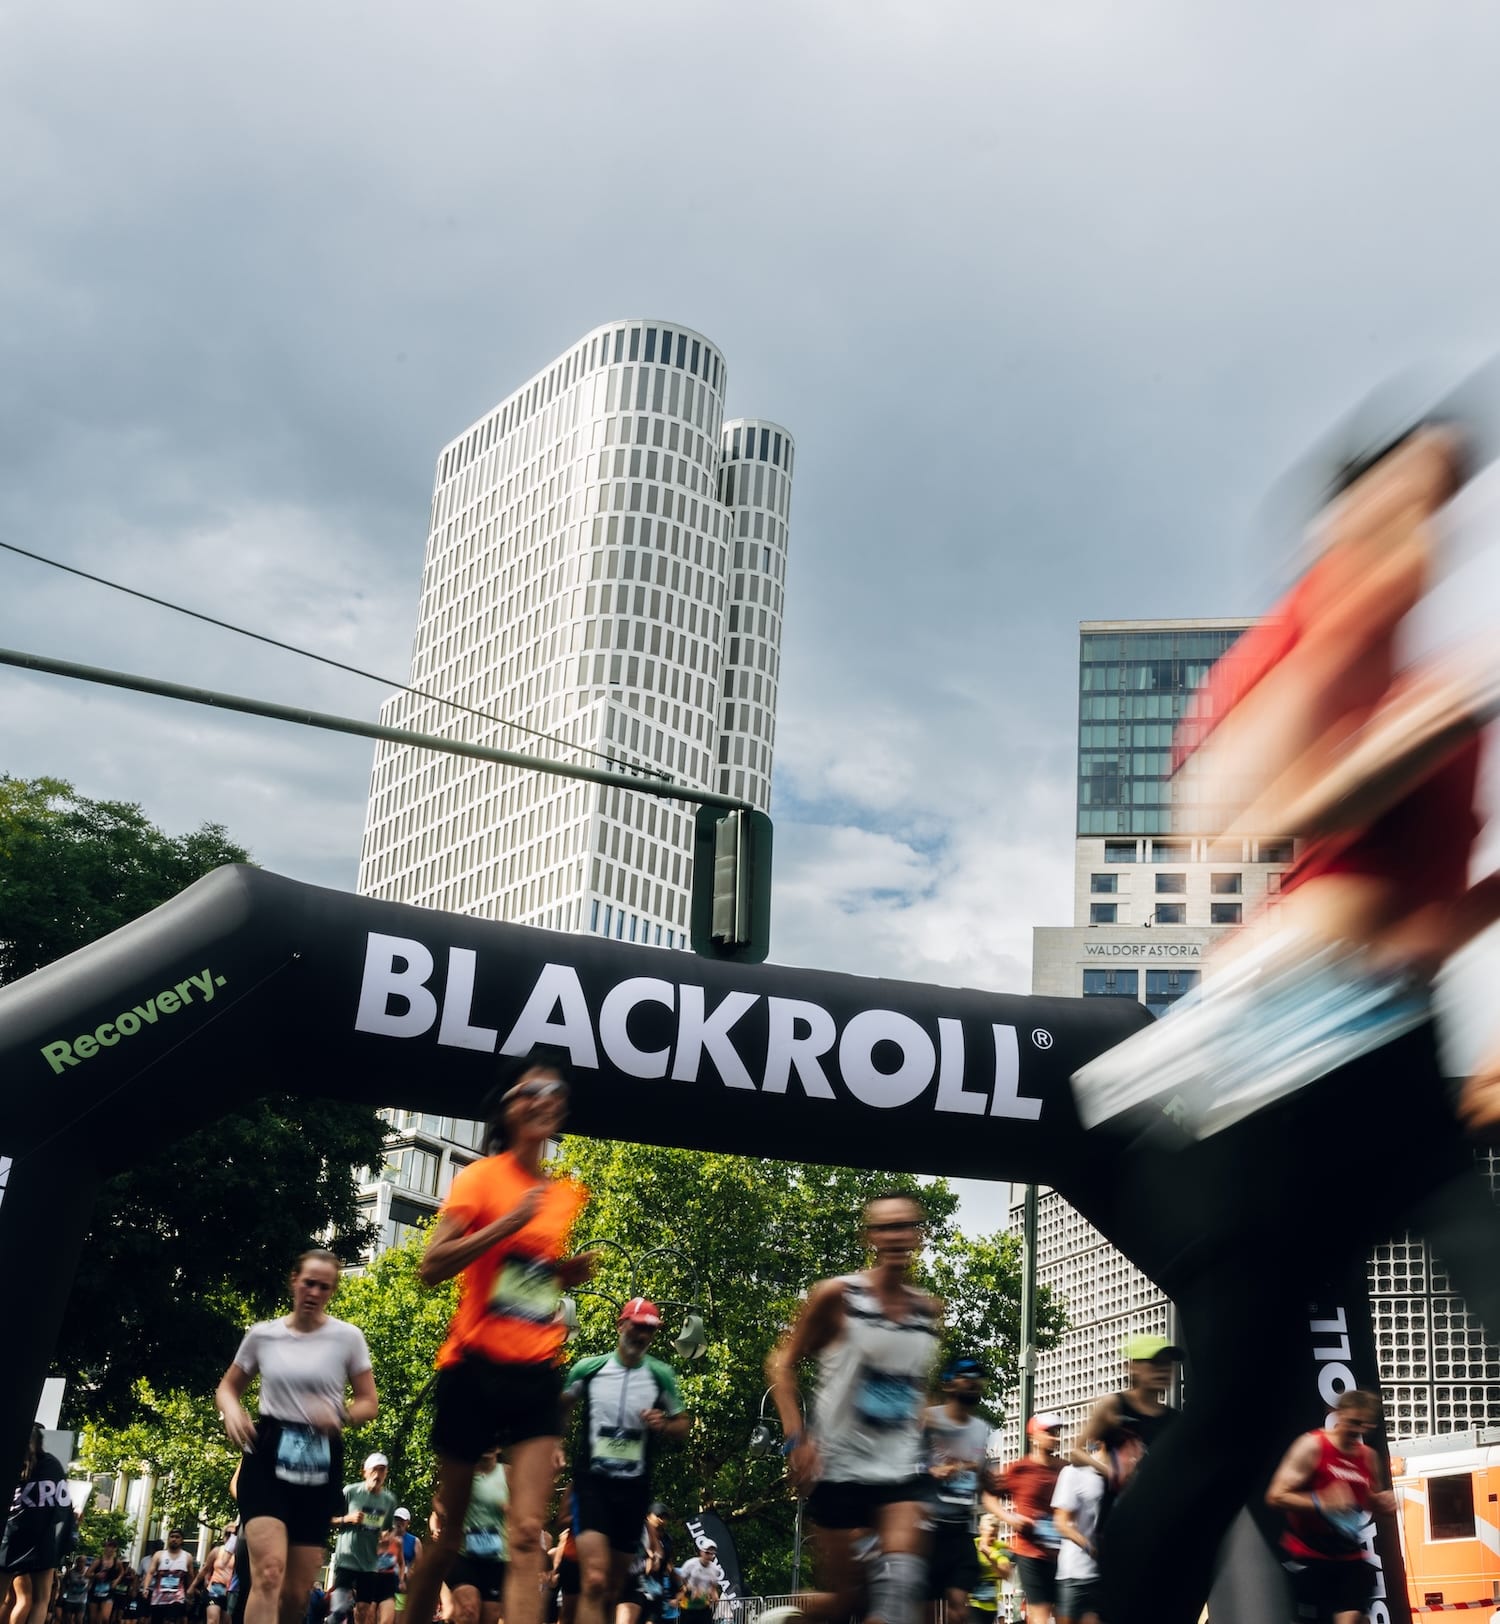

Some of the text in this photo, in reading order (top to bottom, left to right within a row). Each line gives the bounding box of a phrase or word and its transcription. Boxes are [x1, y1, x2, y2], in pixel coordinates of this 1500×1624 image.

[1085, 945, 1200, 956] WALDORF ASTORIA
[41, 968, 227, 1075] Recovery.
